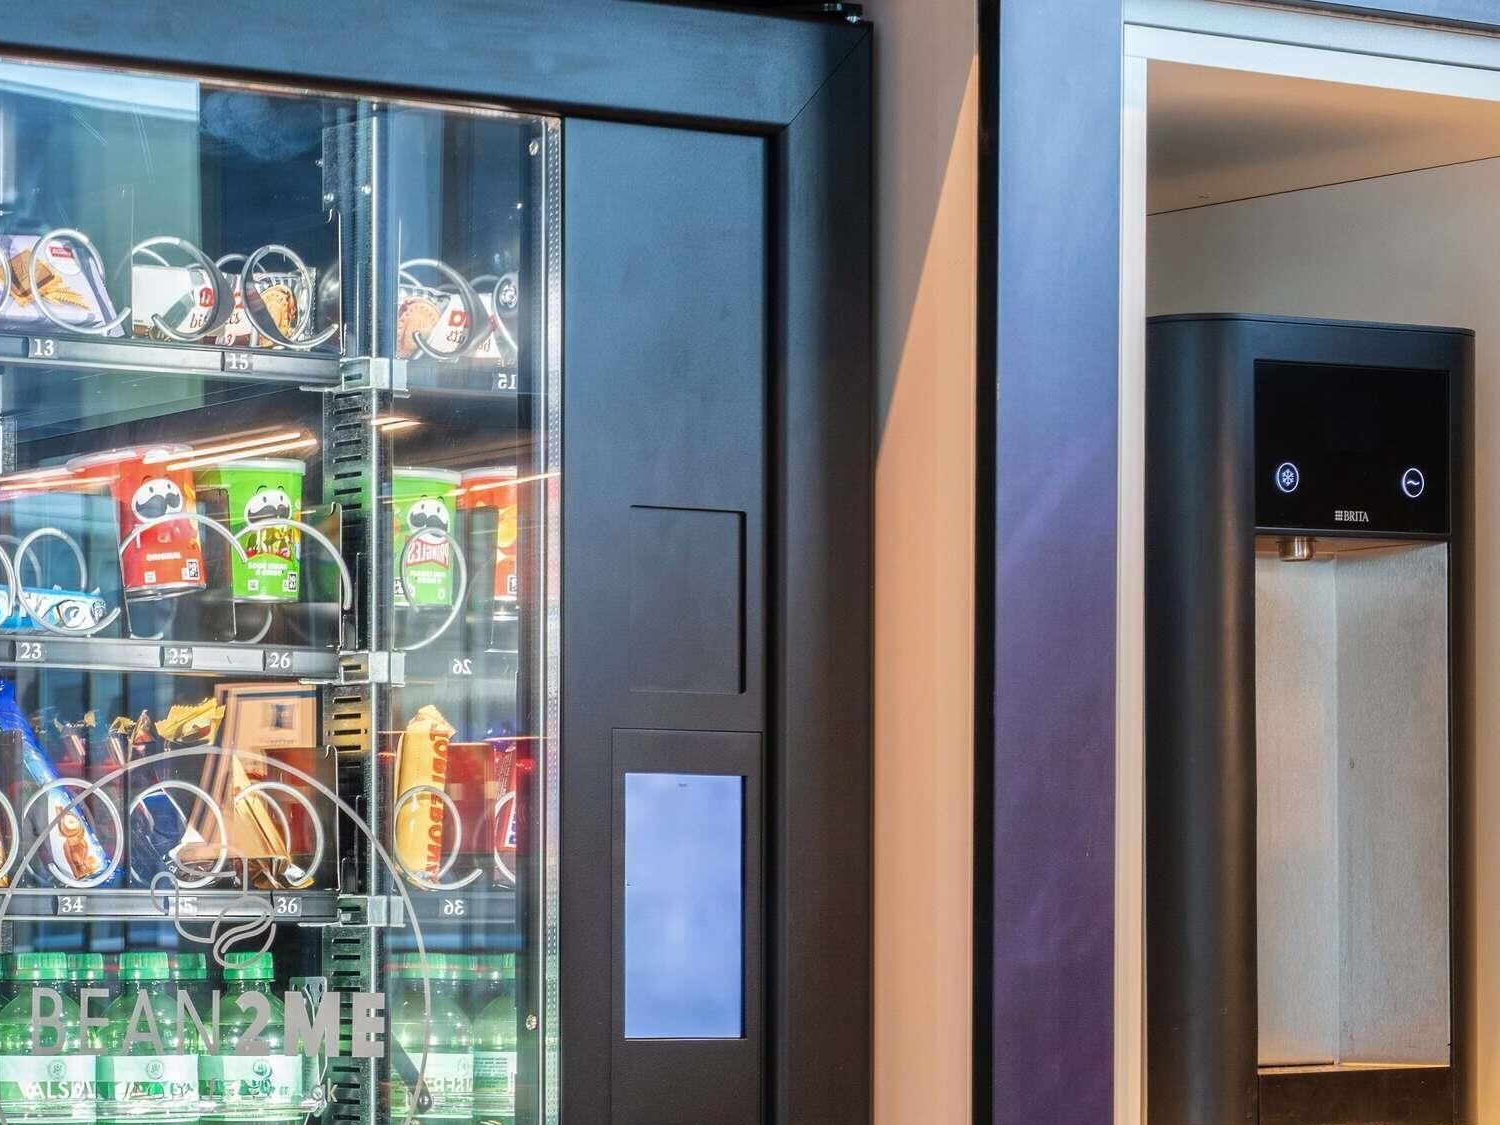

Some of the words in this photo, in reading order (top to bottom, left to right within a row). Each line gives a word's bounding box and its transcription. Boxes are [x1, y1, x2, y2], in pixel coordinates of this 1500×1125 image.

[34, 339, 54, 356] 13
[229, 352, 249, 369] 15
[1344, 510, 1369, 522] BRITA
[146, 552, 182, 561] ORIGINAL
[20, 643, 42, 659] 23
[168, 649, 189, 665] 25
[269, 652, 291, 669] 26
[62, 897, 83, 912] 34
[276, 897, 298, 913] 36
[31, 987, 385, 1057] BEAN2ME
